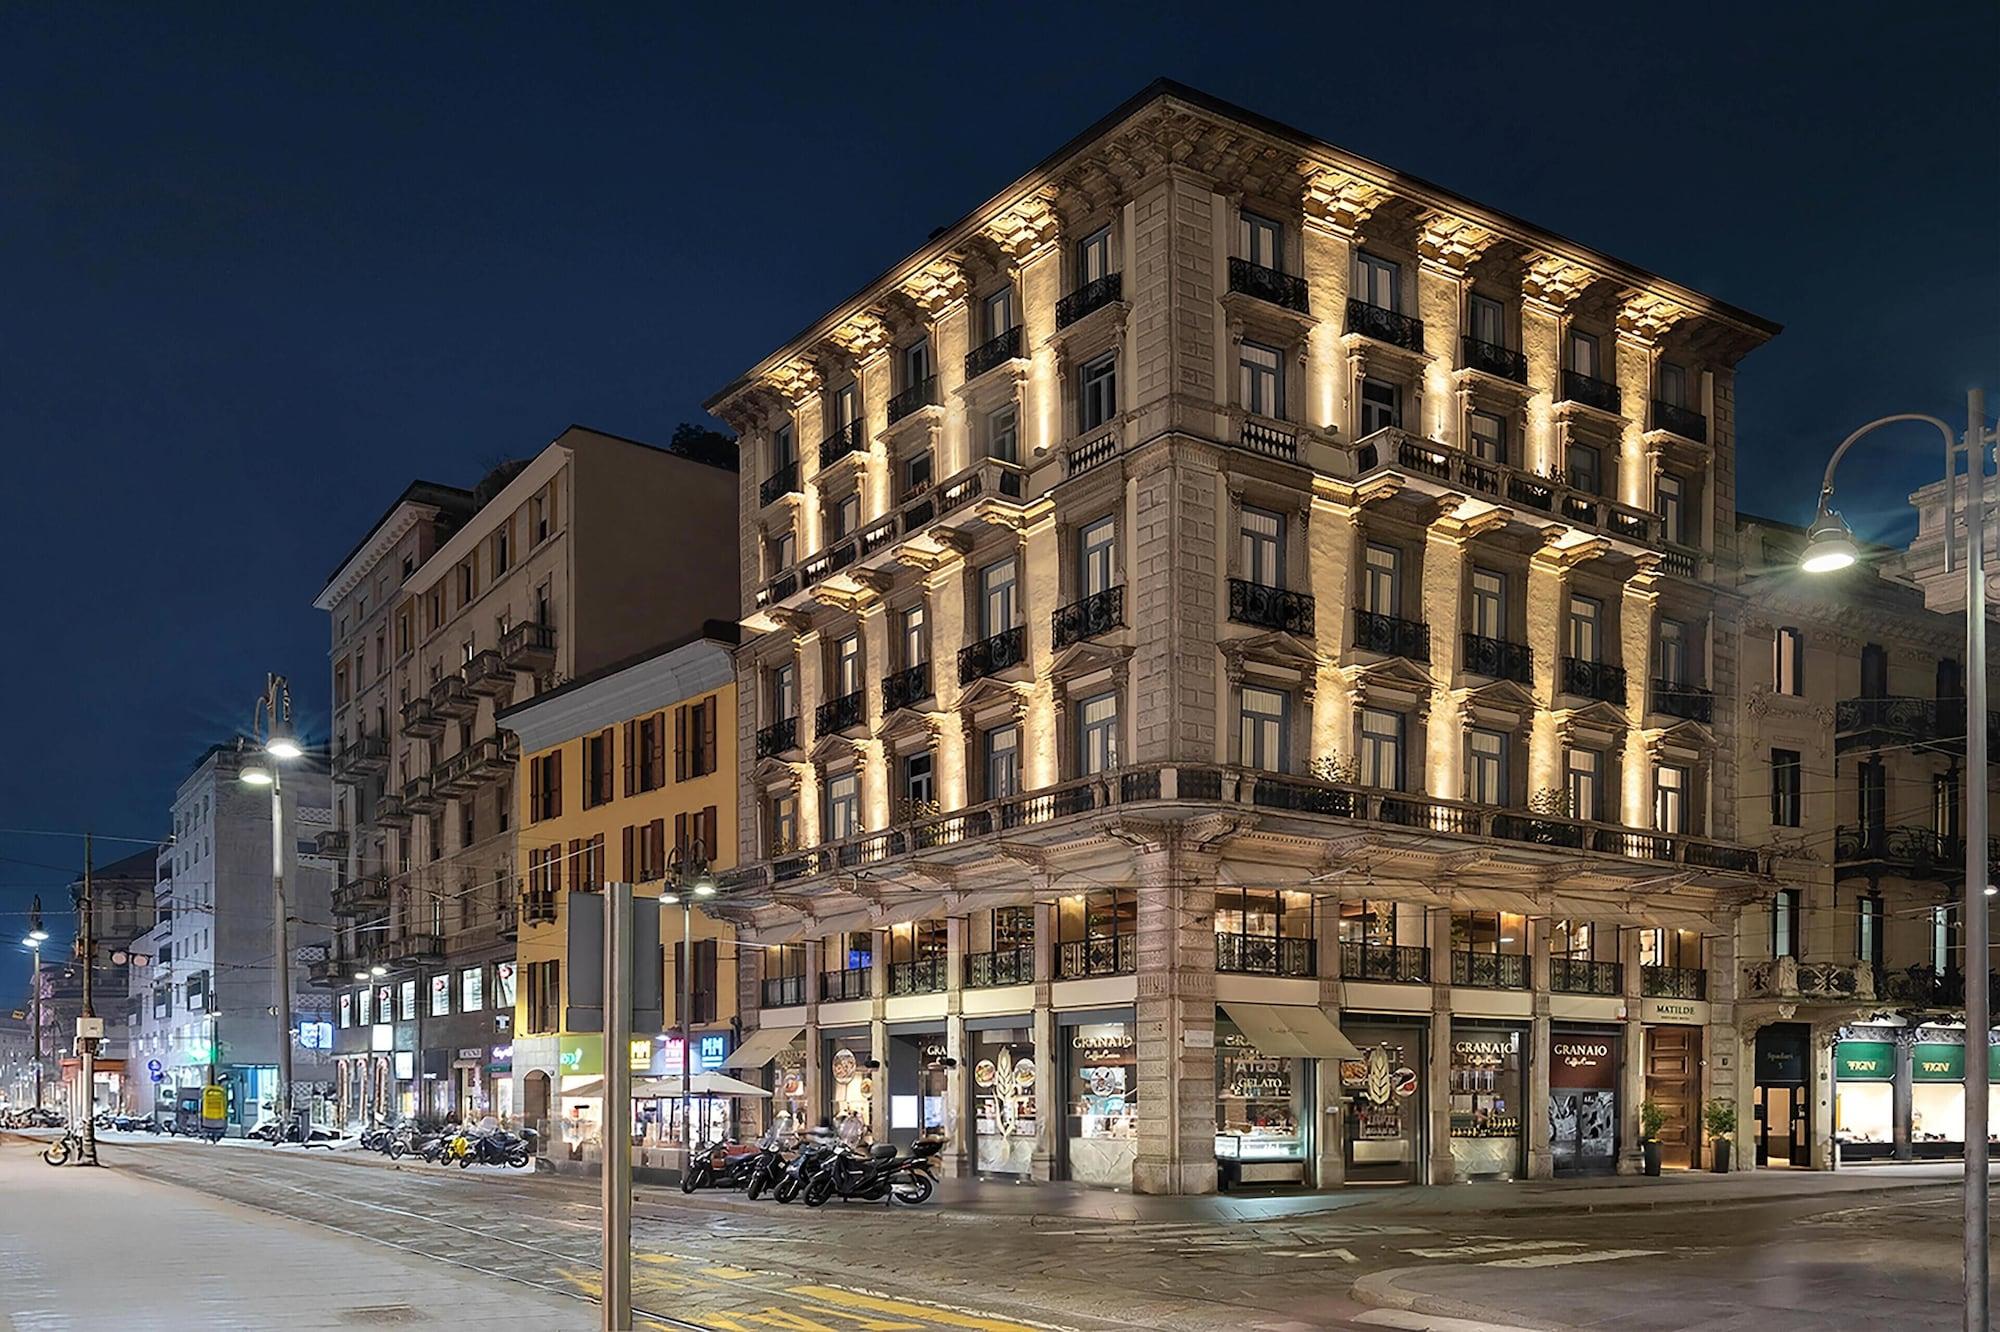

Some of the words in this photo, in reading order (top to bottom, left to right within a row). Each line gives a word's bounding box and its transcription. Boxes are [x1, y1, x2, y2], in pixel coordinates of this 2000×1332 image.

[1656, 1005, 1696, 1015] MATILDE
[1072, 1035, 1133, 1048] GRANAIO
[1456, 1041, 1514, 1054] GRANAIO
[1554, 1044, 1608, 1056] GRANAIO
[1238, 1078, 1282, 1088] GELATO
